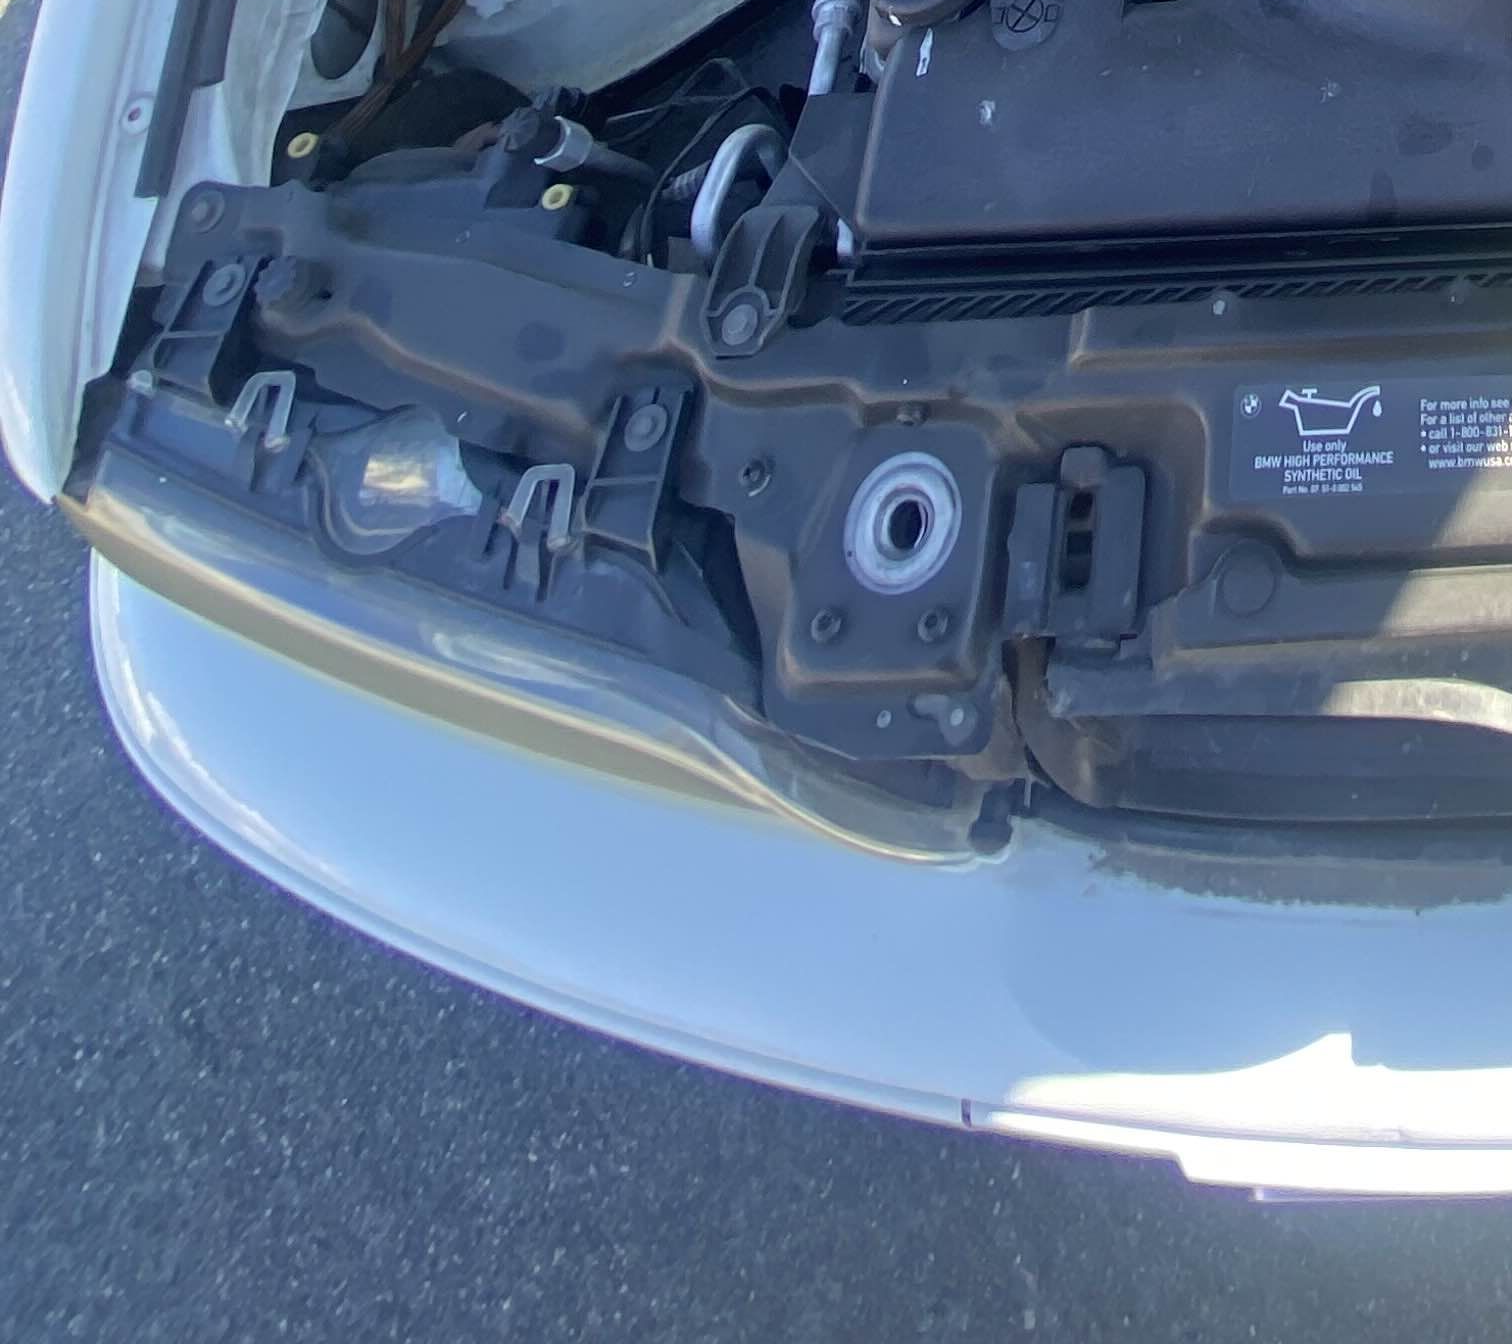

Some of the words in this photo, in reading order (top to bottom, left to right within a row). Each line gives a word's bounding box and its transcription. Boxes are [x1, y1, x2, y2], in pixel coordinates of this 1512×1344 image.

[1420, 399, 1438, 411] For
[1440, 399, 1467, 410] more
[1469, 396, 1489, 409] info
[1491, 398, 1510, 408] see
[1420, 413, 1438, 425] For
[1439, 415, 1446, 424] a
[1449, 412, 1465, 424] list
[1467, 411, 1477, 423] of
[1479, 410, 1506, 423] other
[1428, 427, 1448, 439] call
[1303, 440, 1323, 452] Use
[1325, 439, 1347, 453] only
[1428, 443, 1440, 454] or
[1443, 440, 1464, 453] visit
[1466, 442, 1484, 452] our
[1486, 439, 1509, 452] web
[1254, 456, 1282, 469] BMW
[1283, 454, 1311, 468] HIGH
[1313, 451, 1394, 466] PERFORMANCE
[1284, 468, 1343, 483] SYNTHETIC
[1345, 467, 1363, 480] OIL
